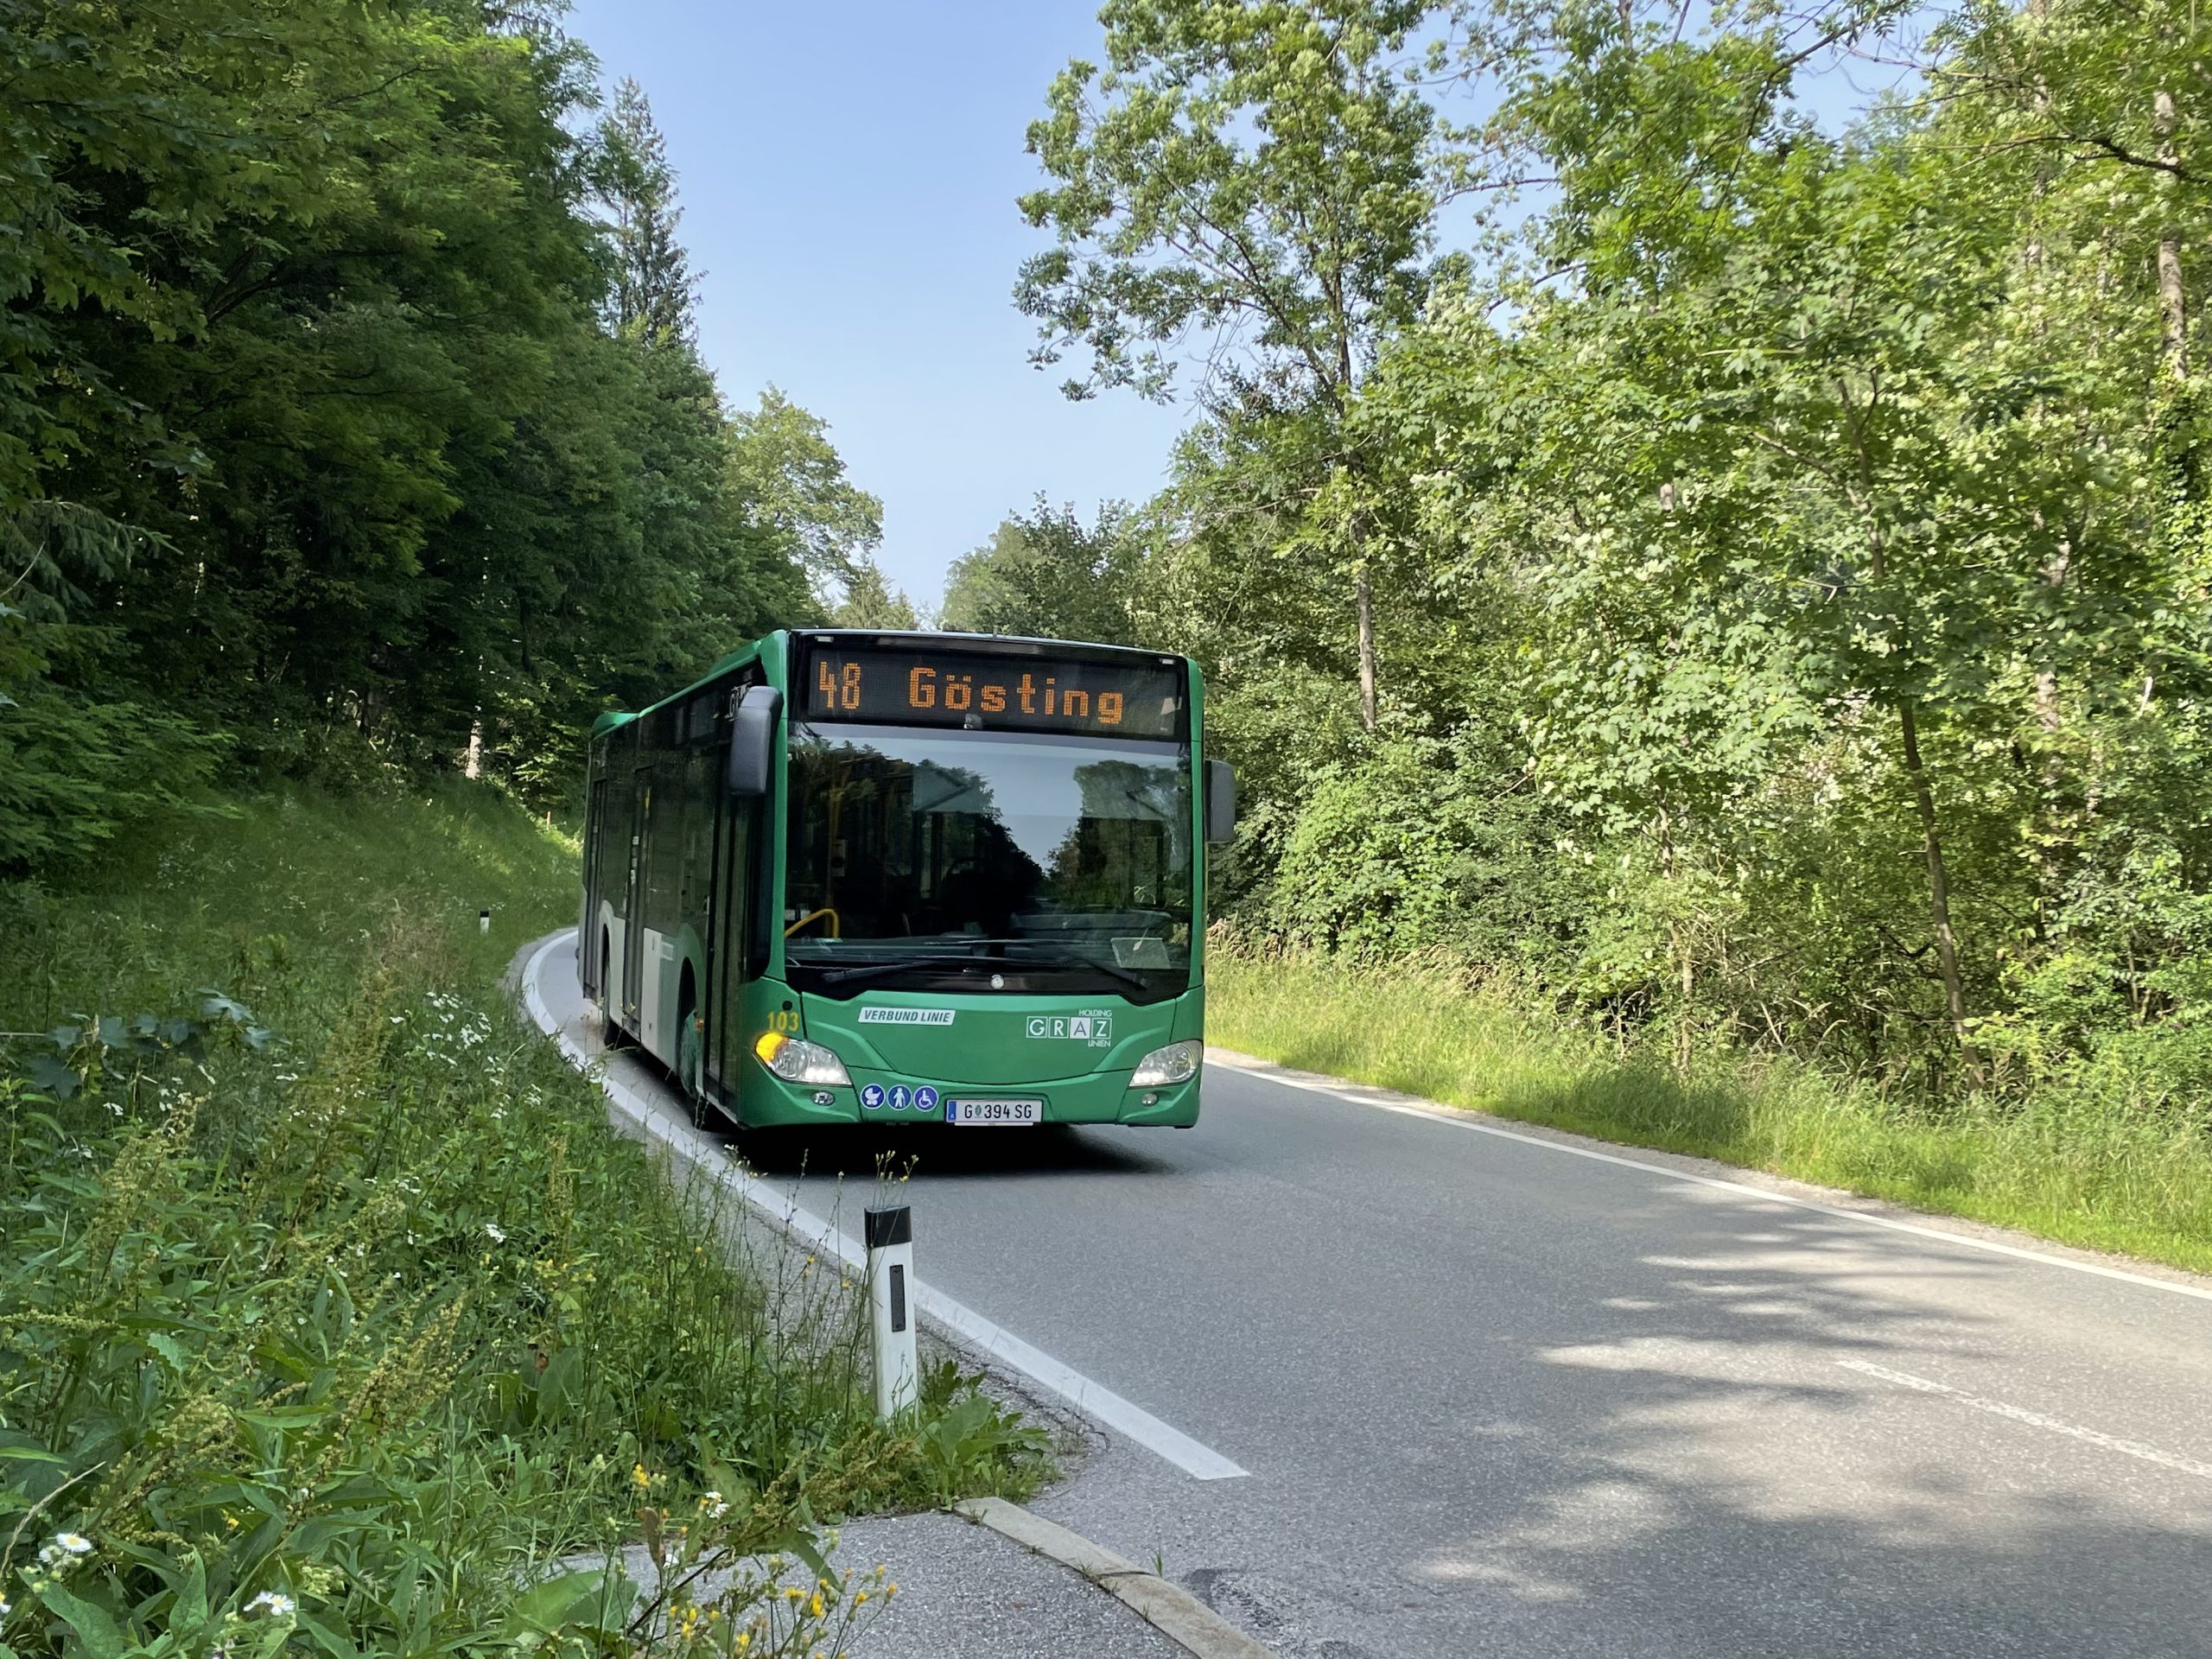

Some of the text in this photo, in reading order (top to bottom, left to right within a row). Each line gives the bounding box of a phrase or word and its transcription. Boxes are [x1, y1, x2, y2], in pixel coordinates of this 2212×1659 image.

[819, 661, 1123, 724] 48 Gösting
[767, 1011, 799, 1032] 103
[864, 1009, 950, 1023] VERBUND LINIE
[1029, 1019, 1107, 1037] GRAZ
[964, 1104, 1033, 1119] G 394 SG
